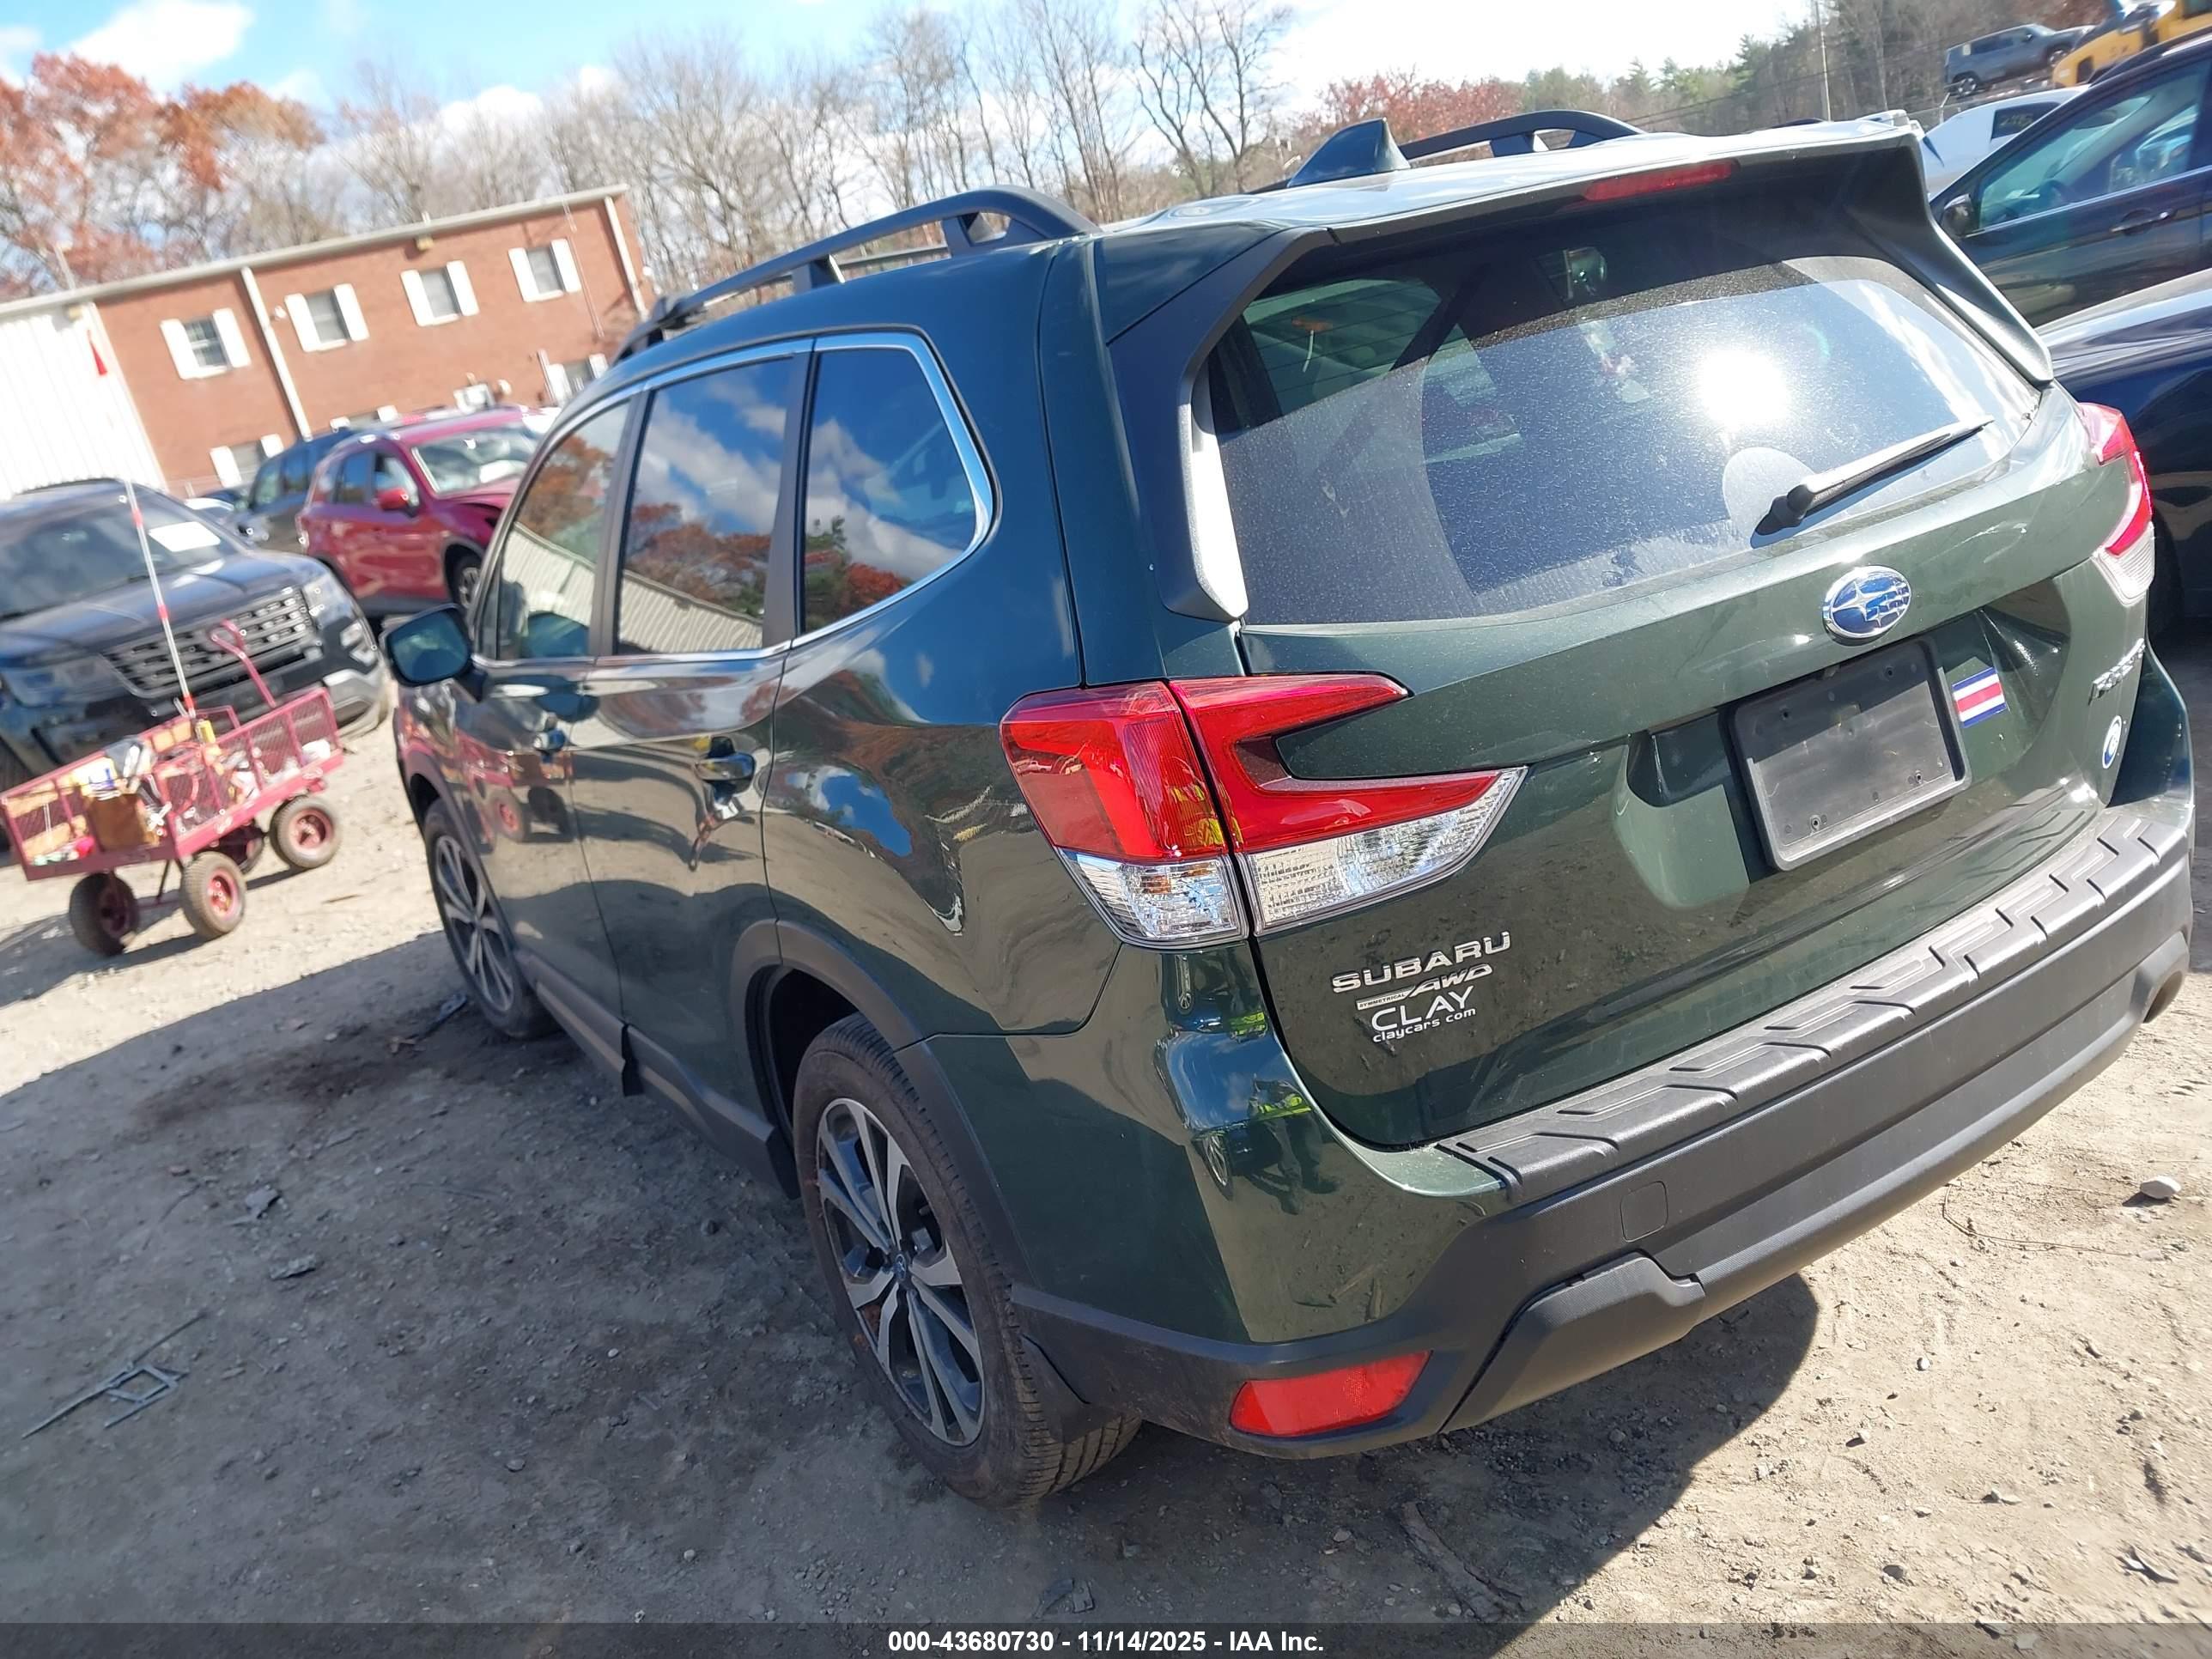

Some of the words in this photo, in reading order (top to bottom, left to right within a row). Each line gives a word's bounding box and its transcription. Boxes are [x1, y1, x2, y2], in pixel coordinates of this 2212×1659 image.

[1332, 930, 1511, 994] SUBARU
[1358, 992, 1407, 1008] SYMMETRICAL
[1408, 963, 1493, 998] AWD
[1371, 985, 1474, 1031] CLAY
